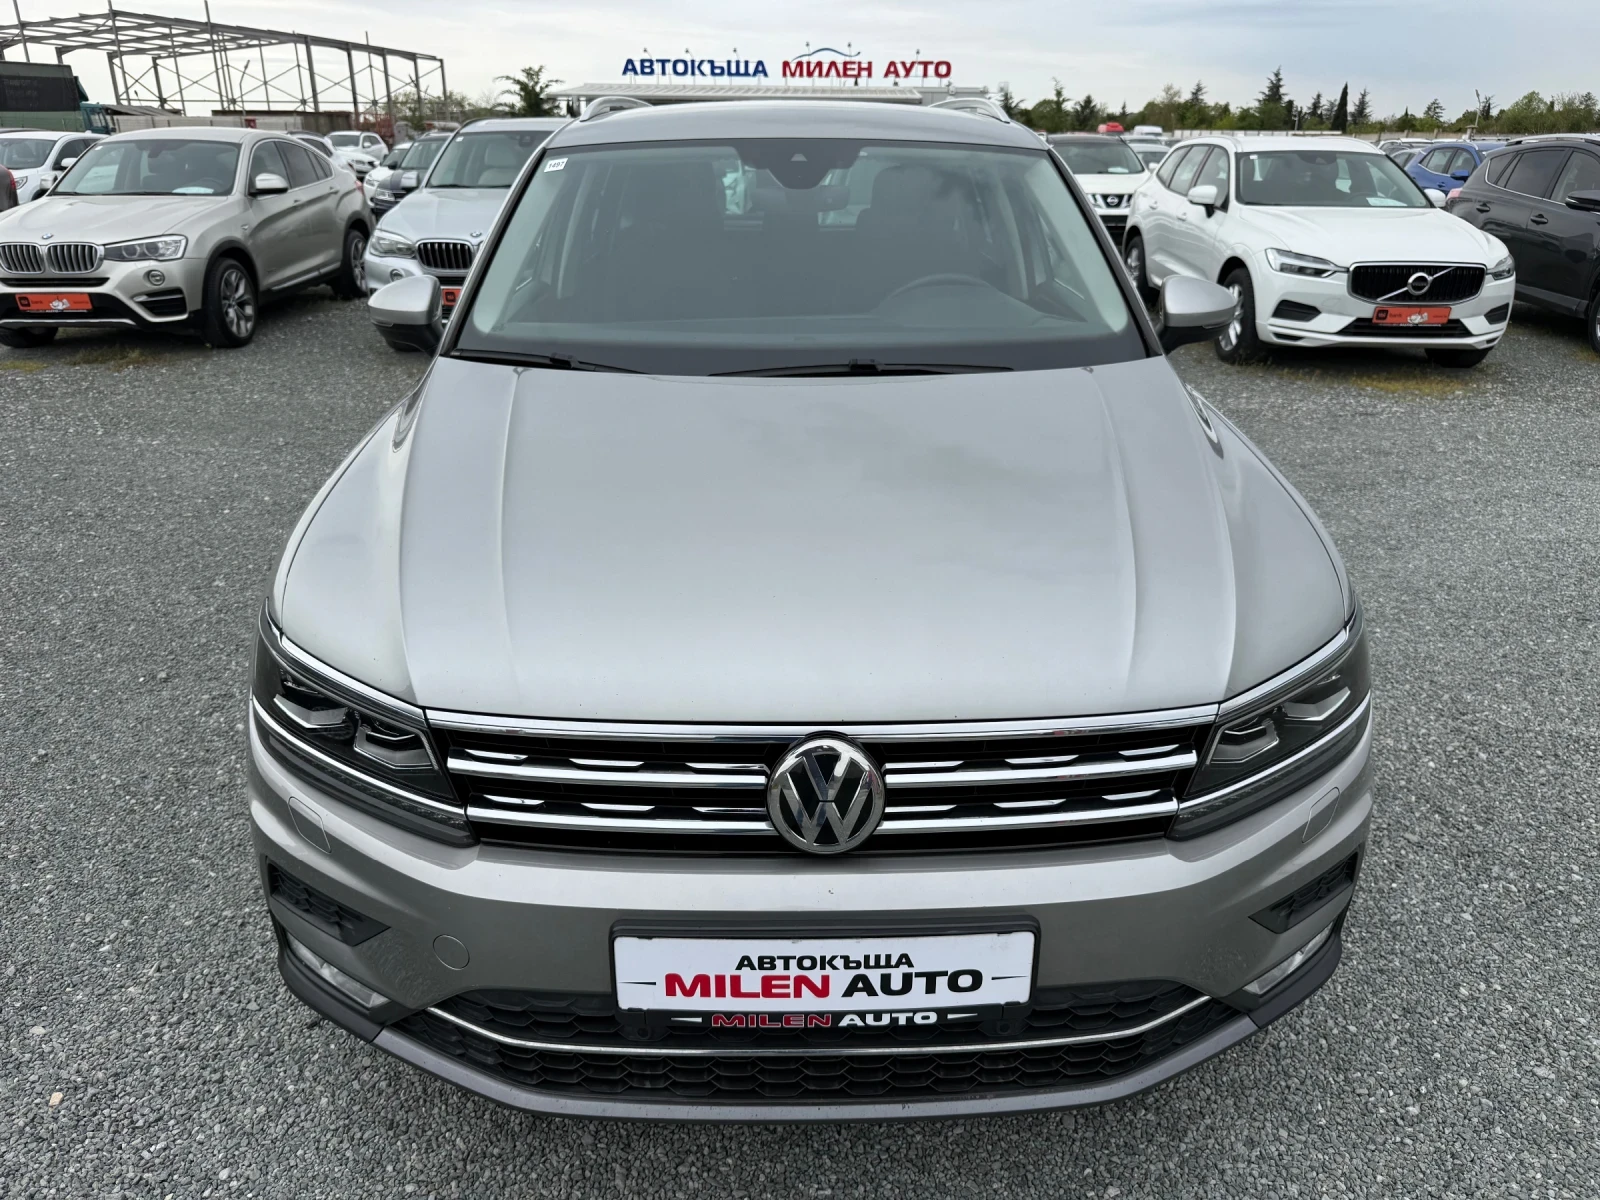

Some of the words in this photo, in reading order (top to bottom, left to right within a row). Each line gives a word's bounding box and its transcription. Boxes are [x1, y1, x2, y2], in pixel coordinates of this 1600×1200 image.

[622, 58, 768, 78] АВТОКЪЩА
[782, 60, 873, 79] МИЛЕН
[883, 60, 952, 79] АУТО
[548, 161, 565, 169] 1497
[735, 952, 915, 971] АВТОКЪЩА
[664, 972, 831, 999] MILEN
[840, 969, 983, 998] AUTO
[711, 1013, 832, 1028] MILEN
[837, 1011, 938, 1027] AUTO
